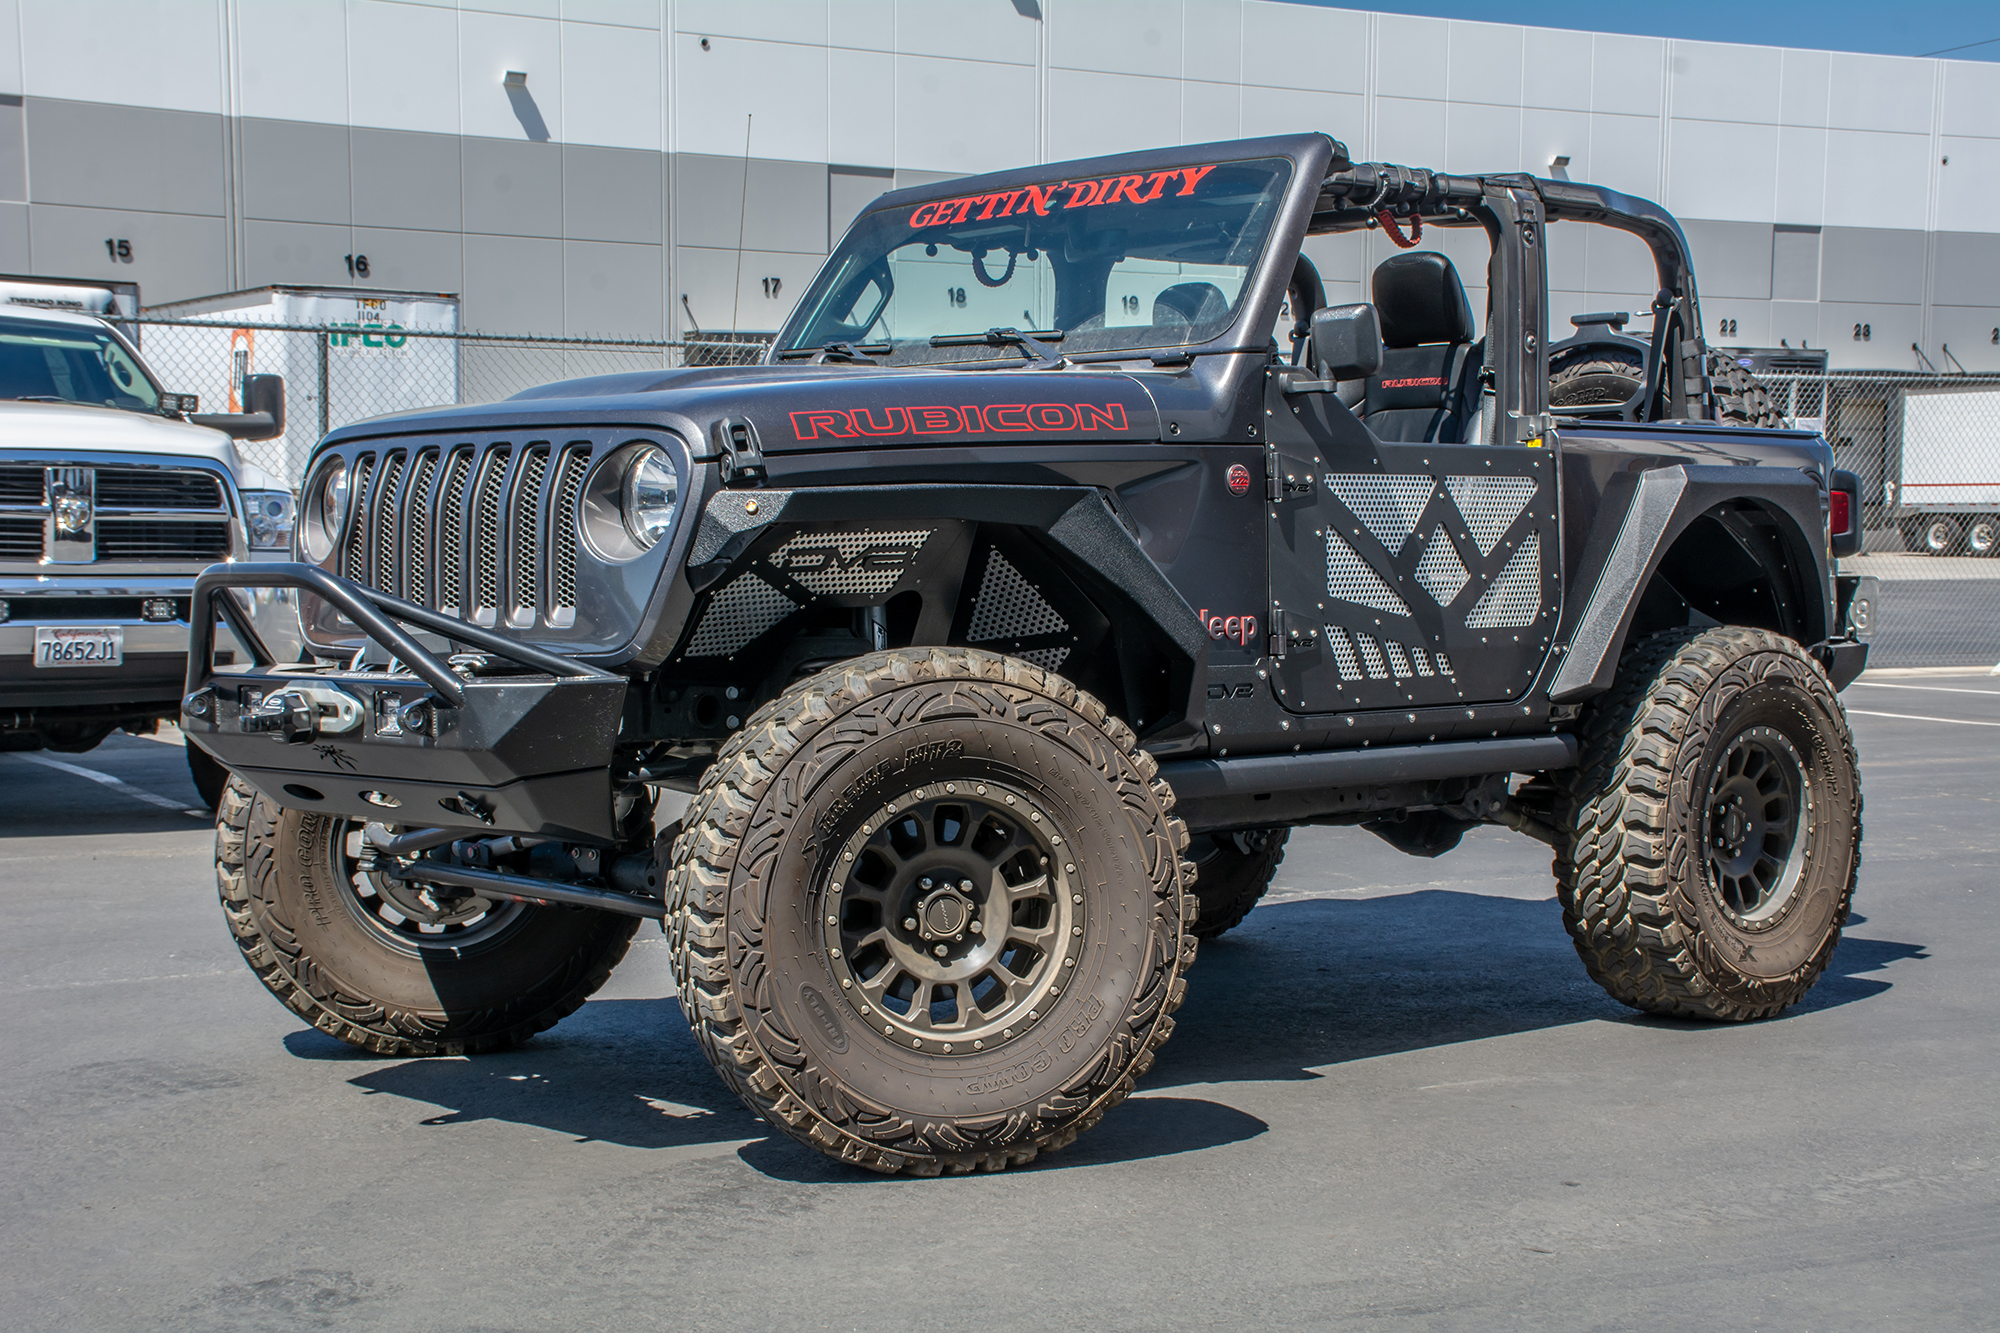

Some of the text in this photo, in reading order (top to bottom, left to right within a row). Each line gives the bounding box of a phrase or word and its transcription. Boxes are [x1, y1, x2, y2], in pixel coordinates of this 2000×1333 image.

[105, 238, 131, 257] 15
[344, 254, 370, 273] 16
[762, 277, 781, 294] 17
[9, 297, 83, 308] THERMO KING
[948, 287, 966, 303] 18
[1121, 295, 1139, 310] 19
[1720, 319, 1737, 332] 22
[1853, 323, 1871, 336] 23
[330, 322, 407, 348] IFCO
[1382, 377, 1448, 389] RUBICON
[789, 403, 1129, 440] RUBICON
[54, 629, 104, 641] California
[41, 641, 117, 661] 78652J1
[803, 990, 845, 1047] TRI-PLY
[1057, 993, 1105, 1054] PRO
[965, 1050, 1051, 1096] COMP
